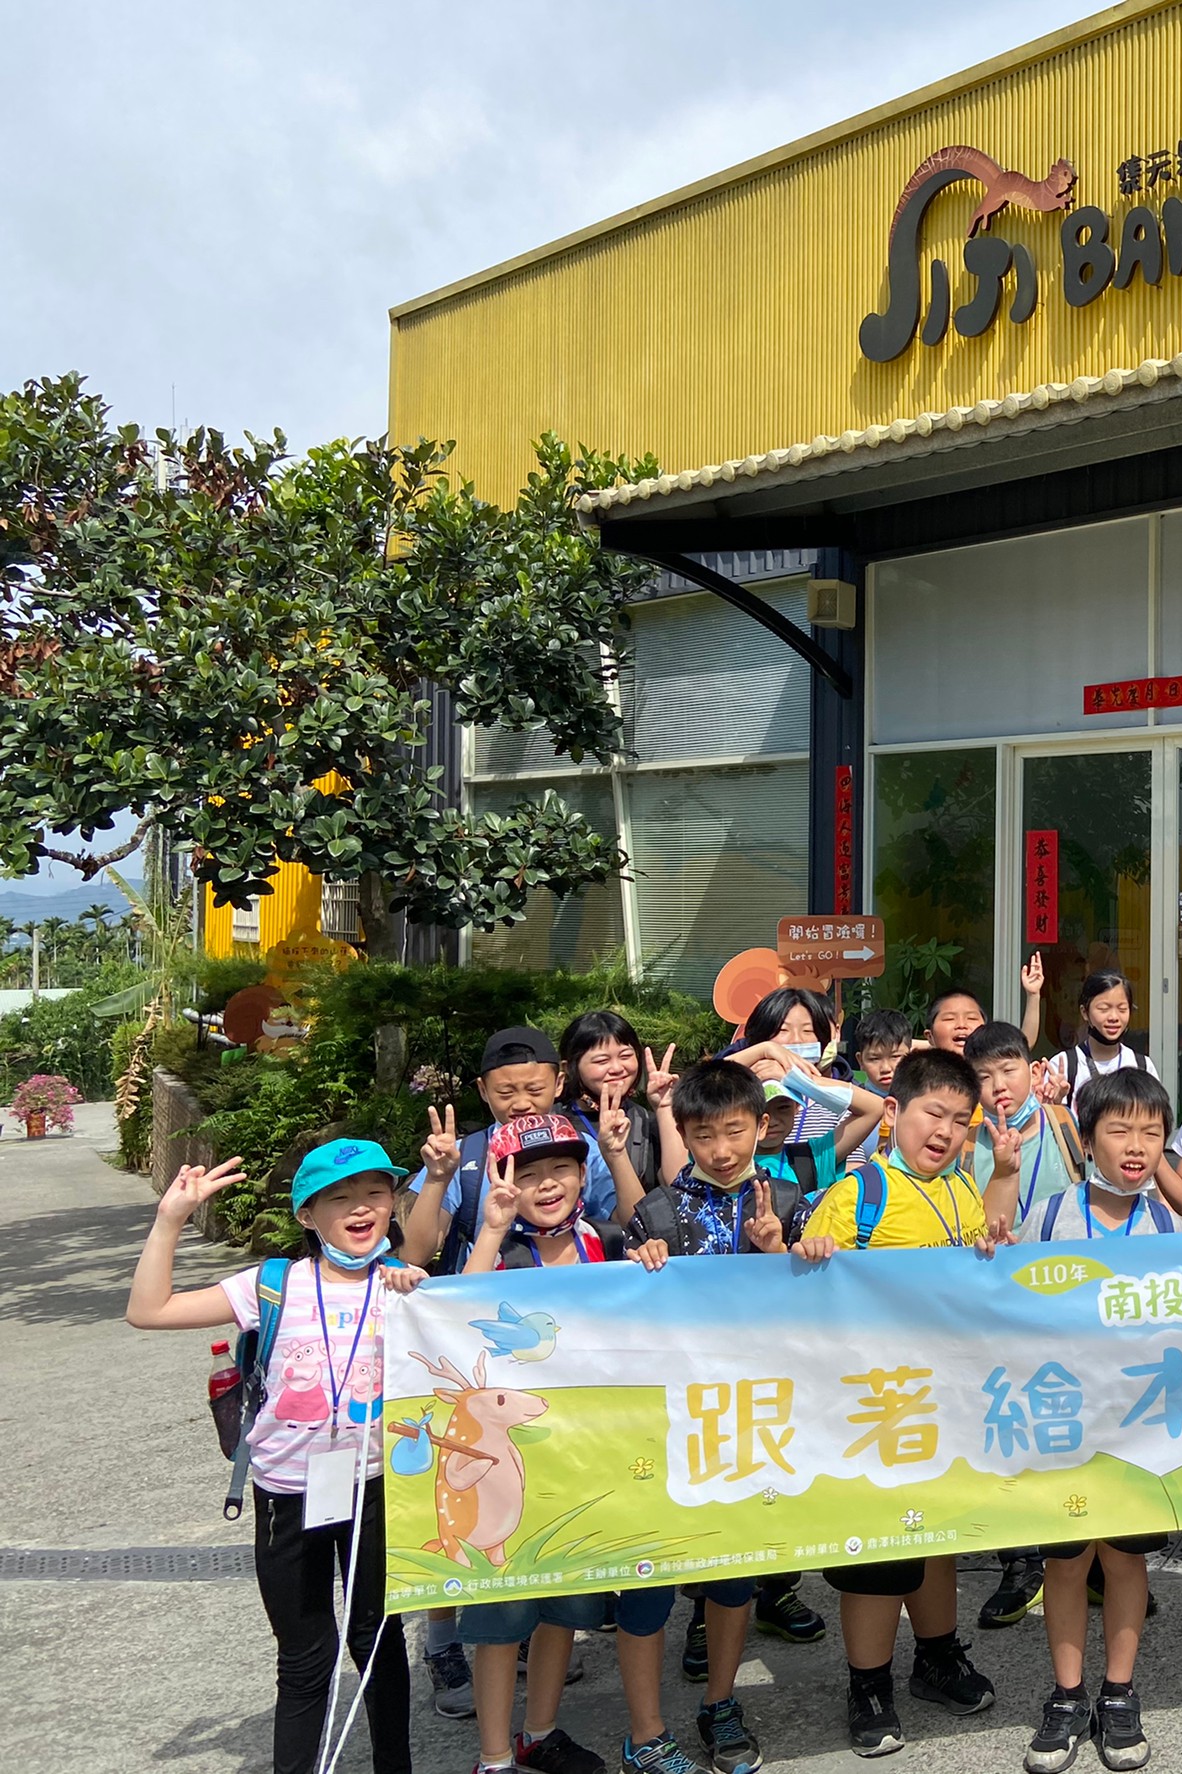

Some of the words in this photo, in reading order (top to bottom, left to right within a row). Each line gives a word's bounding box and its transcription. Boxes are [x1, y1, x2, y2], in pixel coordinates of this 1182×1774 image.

[1034, 838, 1050, 934] 恭喜發財
[789, 950, 813, 961] Let's
[1027, 1262, 1089, 1287] 110年
[389, 1584, 438, 1600] 指導單位
[467, 1571, 563, 1591] 行政院環境保護署
[584, 1566, 631, 1581] 主辦單位
[660, 1549, 777, 1573] 南投縣政府環境保護局
[793, 1543, 840, 1557] 承辦單位
[867, 1530, 957, 1549] 鼎澤科技有限公司
